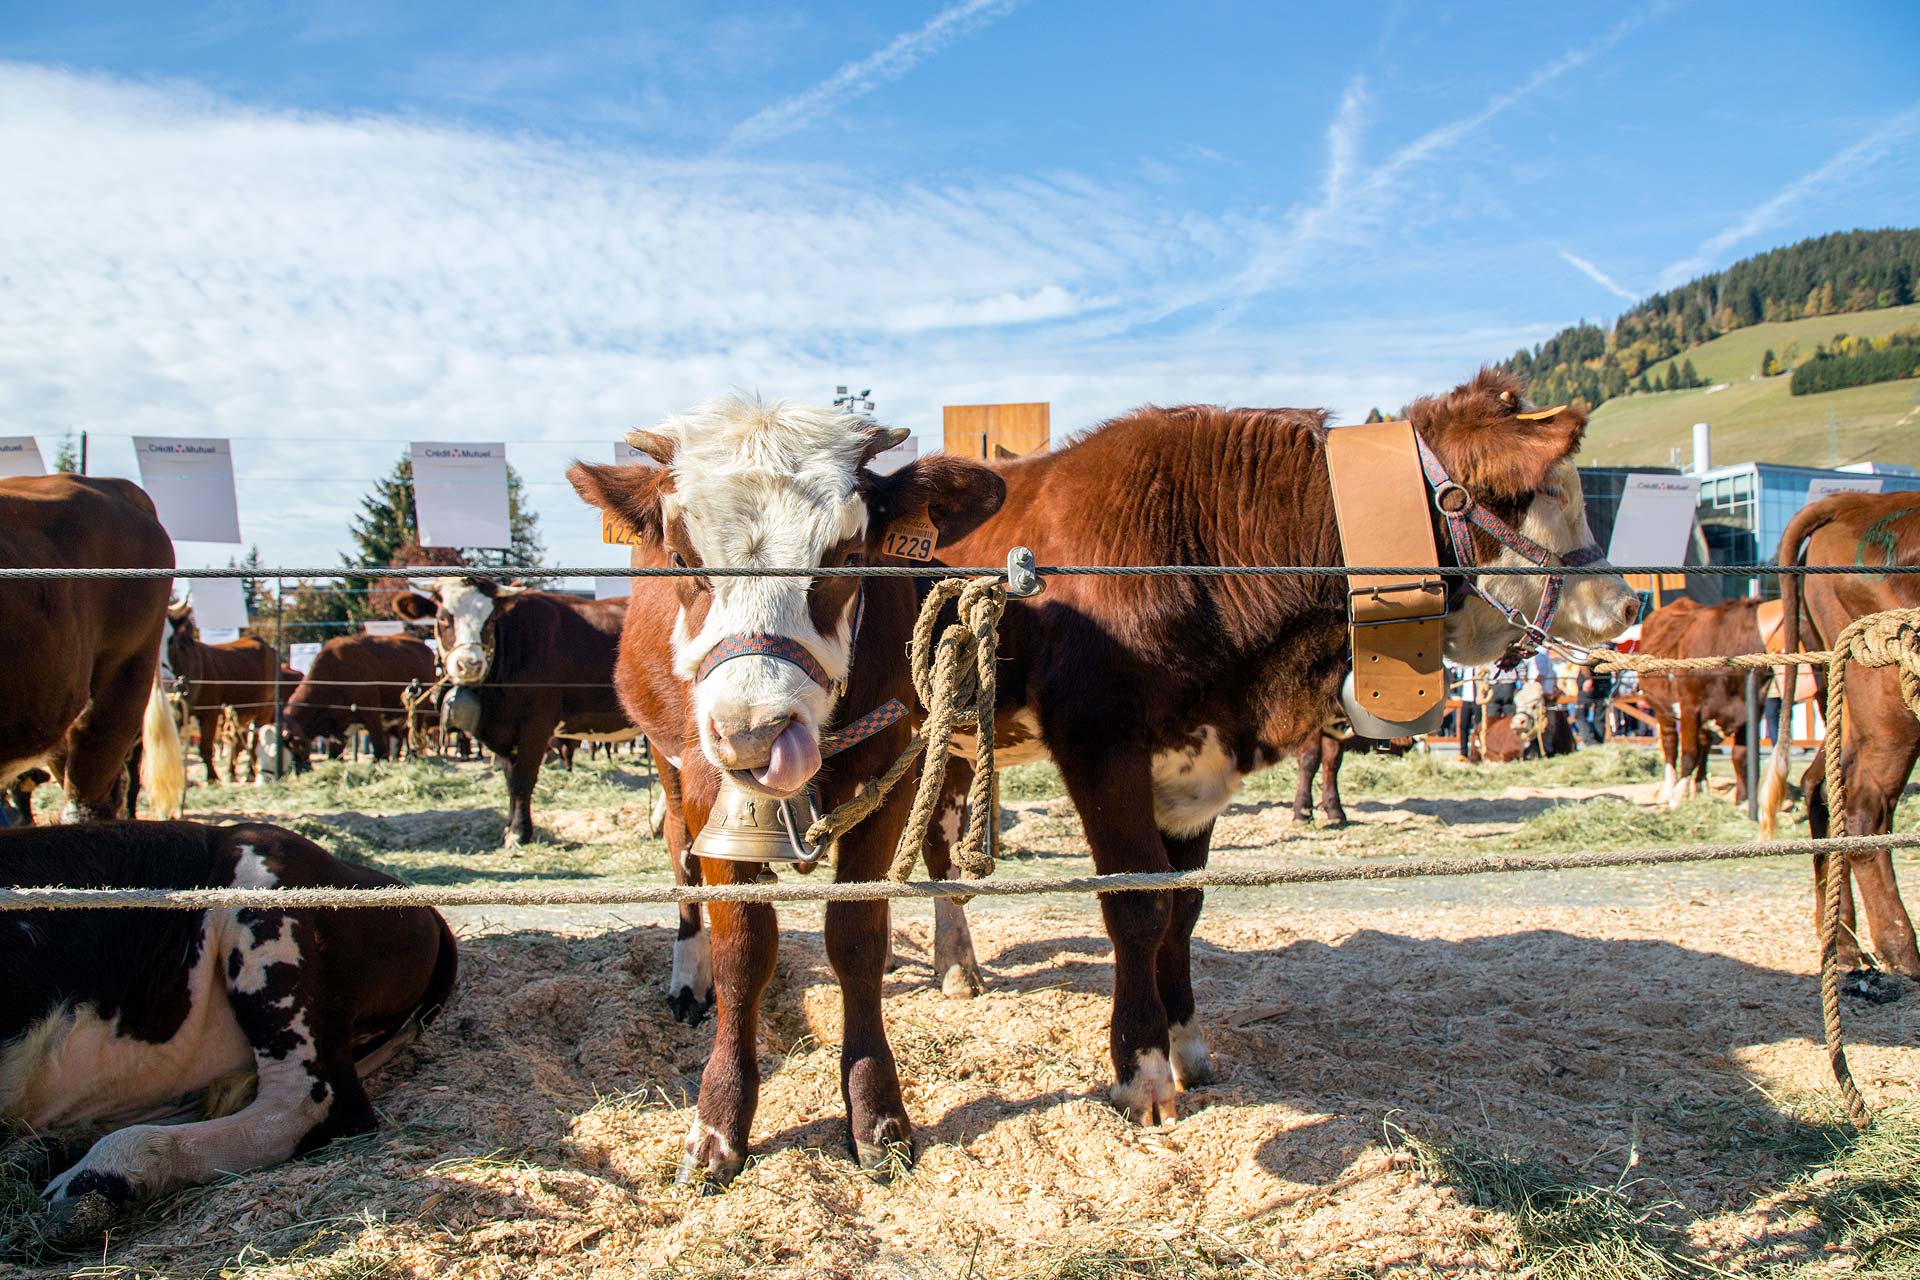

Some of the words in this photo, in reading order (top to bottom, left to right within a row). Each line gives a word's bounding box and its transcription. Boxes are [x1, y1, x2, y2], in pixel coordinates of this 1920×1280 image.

[148, 443, 174, 453] Crédit
[185, 445, 216, 454] Mutuel
[425, 449, 451, 458] Crédit
[461, 449, 491, 458] Mutuel
[887, 533, 931, 559] 1229
